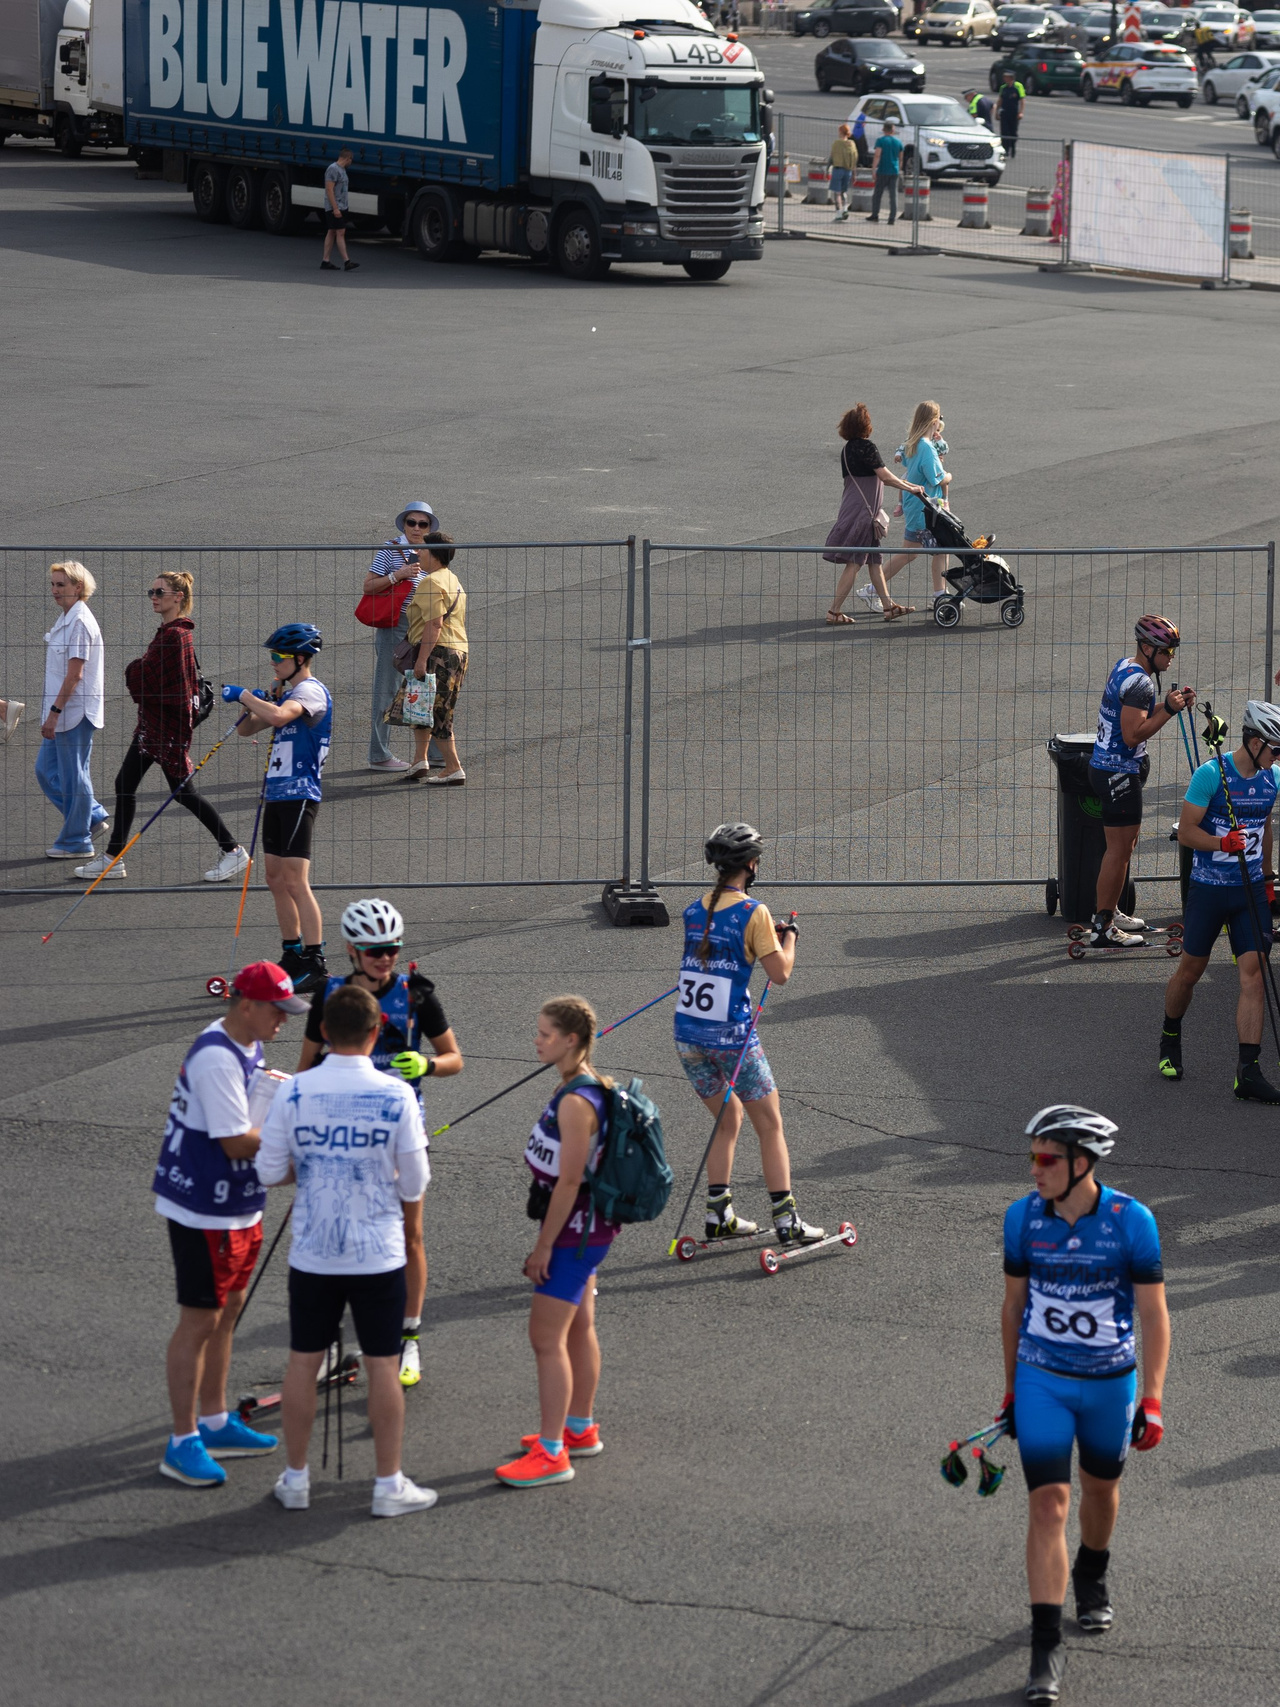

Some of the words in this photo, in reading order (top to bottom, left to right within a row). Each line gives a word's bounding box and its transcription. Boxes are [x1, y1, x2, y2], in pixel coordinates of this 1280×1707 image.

[667, 43, 723, 64] L4B
[150, 0, 270, 121] BLUE
[280, 0, 467, 144] WATER
[608, 170, 622, 181] L4B
[681, 978, 715, 1012] 36
[293, 1124, 390, 1151] СУДЬЯ
[213, 1180, 230, 1204] 9
[1043, 1305, 1099, 1340] 60
